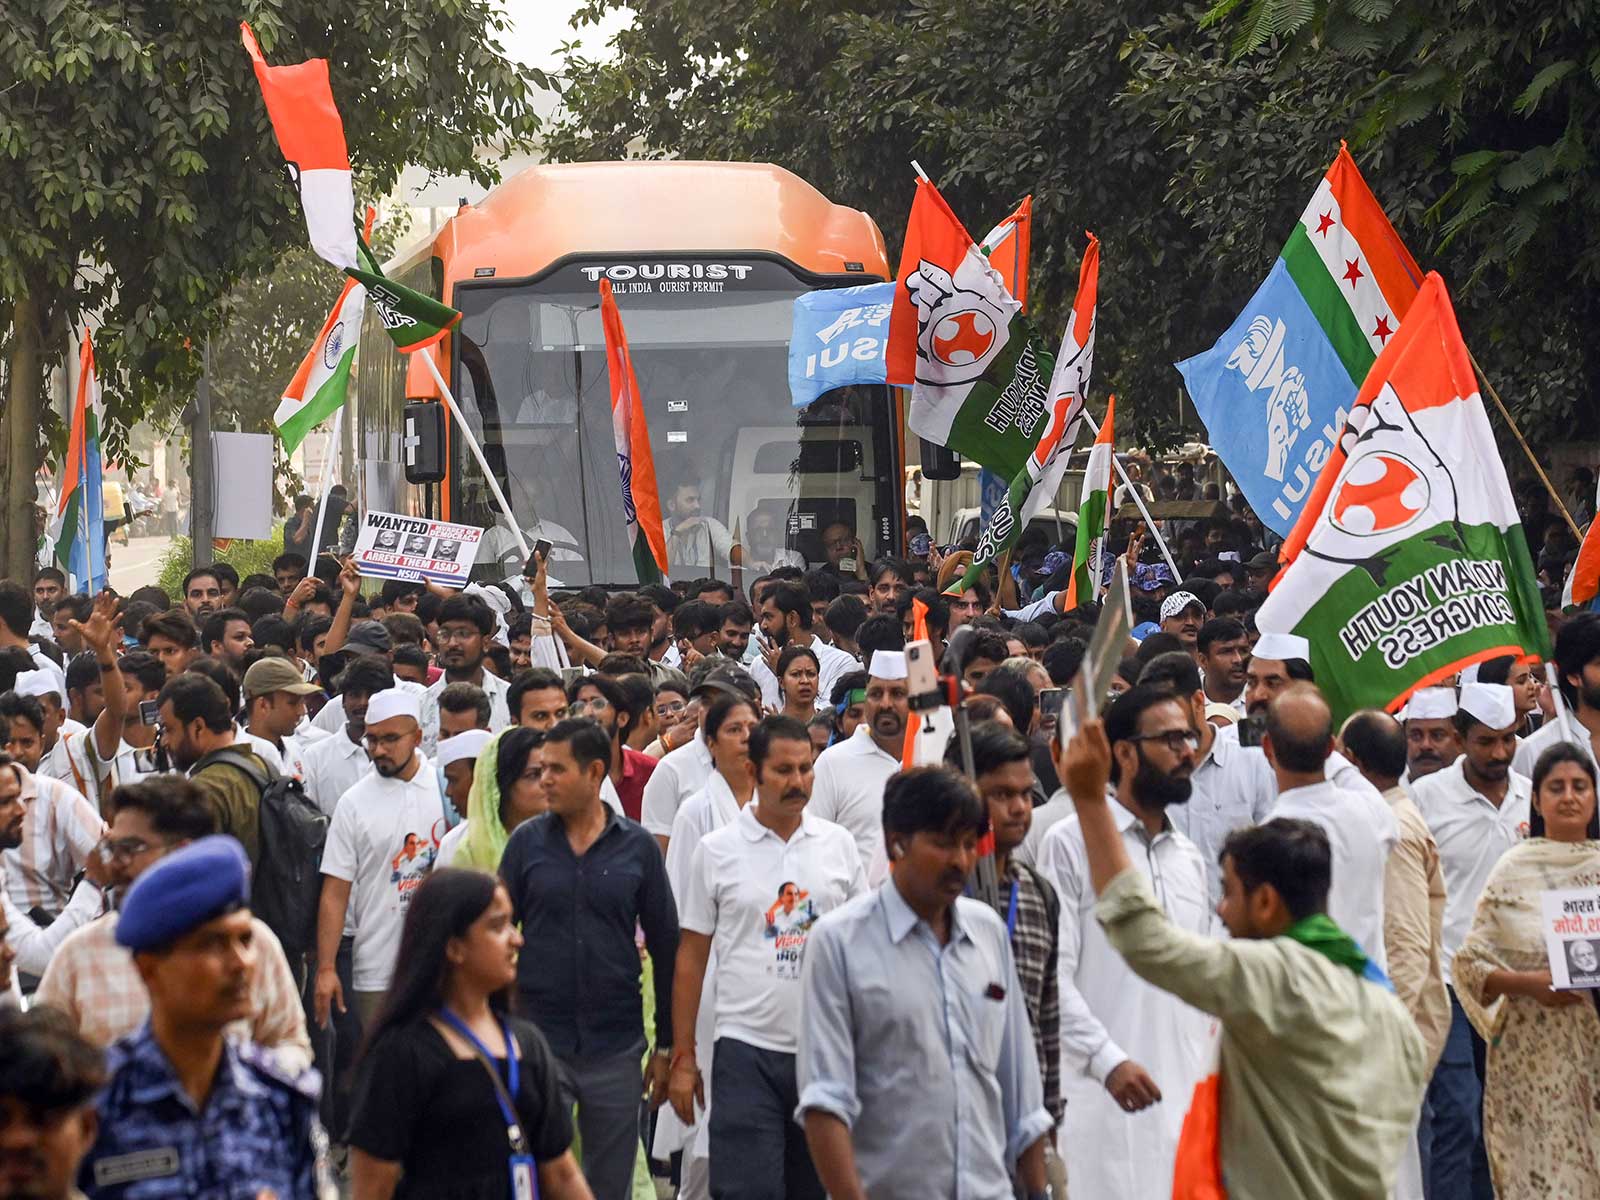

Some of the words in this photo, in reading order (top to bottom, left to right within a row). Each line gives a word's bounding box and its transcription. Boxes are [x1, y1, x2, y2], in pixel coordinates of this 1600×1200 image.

[580, 264, 753, 282] TOURIST
[611, 283, 627, 294] ALL
[629, 282, 652, 293] INDIA
[692, 281, 724, 293] PERMIT
[367, 514, 429, 535] WANTED
[430, 530, 479, 542] DEMOCRACY
[365, 551, 399, 565] ARREST
[402, 557, 432, 569] THEM
[433, 561, 459, 573] ASAP
[397, 569, 420, 579] NSUI
[1563, 899, 1594, 912] भारत
[776, 950, 800, 962] IND
